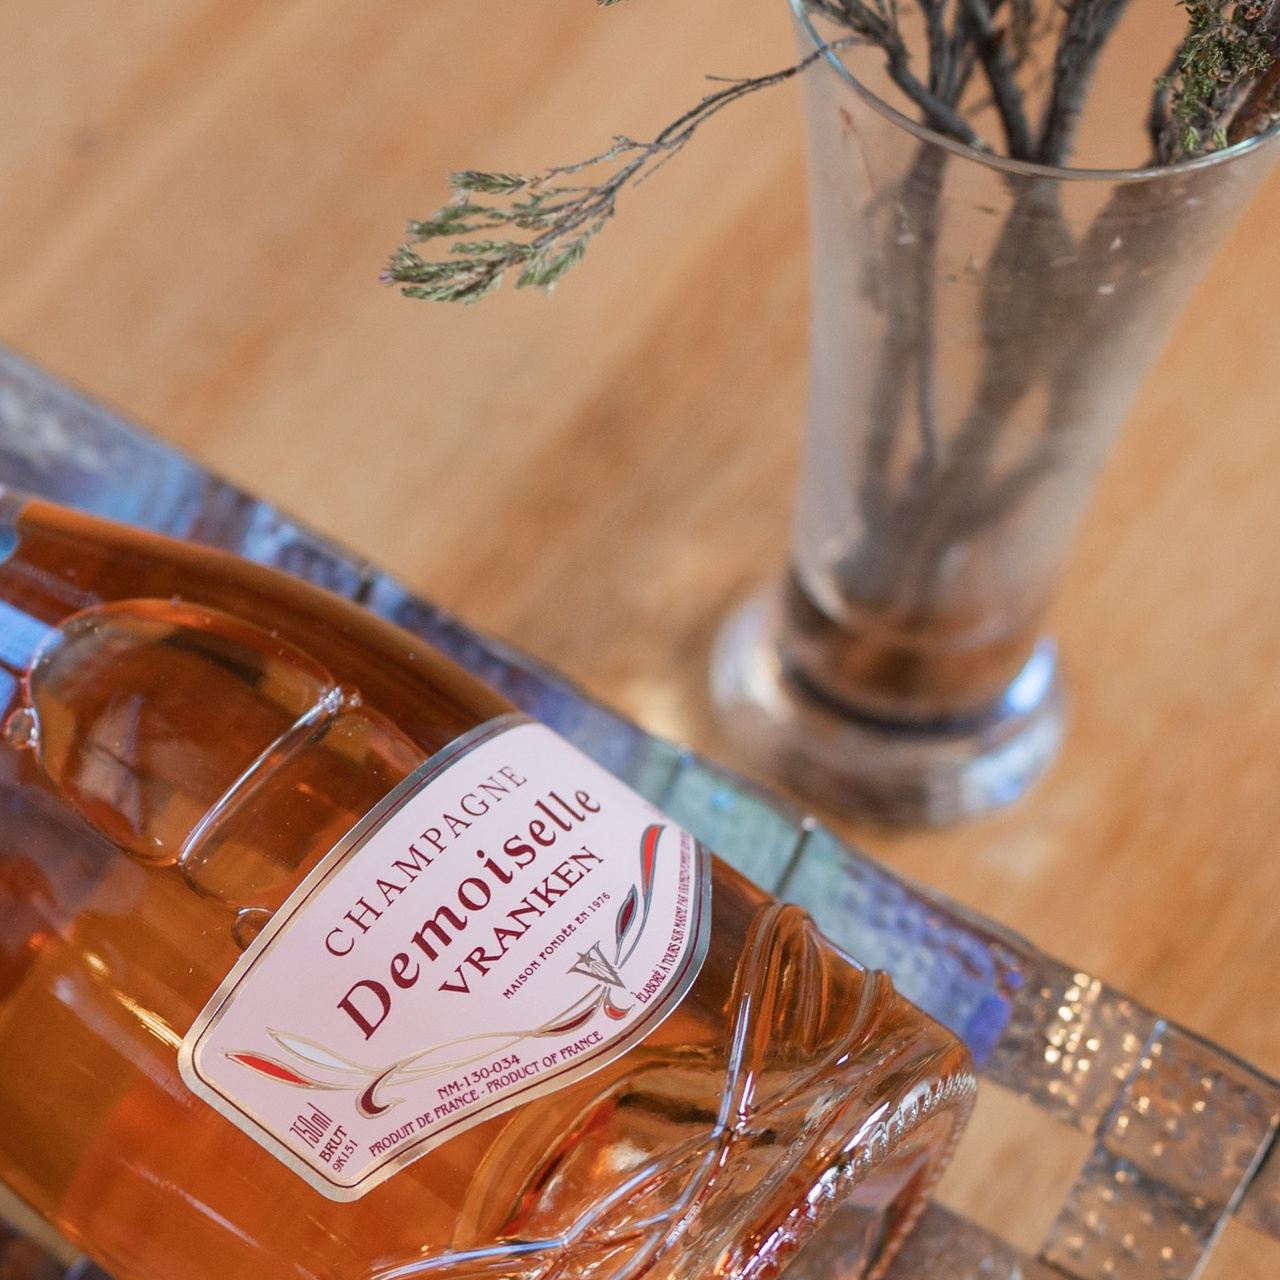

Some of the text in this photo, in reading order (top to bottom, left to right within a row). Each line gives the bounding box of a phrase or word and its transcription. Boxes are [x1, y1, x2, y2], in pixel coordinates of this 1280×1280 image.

[325, 765, 528, 957] CHAMPAGNE
[336, 788, 602, 1041] Demoiselle
[437, 846, 604, 997] VRANKEN
[670, 926, 685, 946] SUR
[503, 892, 611, 999] MAISON FONDÉE EN 1976
[661, 943, 681, 969] TOURS
[635, 969, 667, 1004] ÉLABORÉ
[368, 1121, 415, 1157] PRODUIT
[415, 1112, 434, 1128] DE
[434, 1089, 480, 1120] FRANCE
[487, 1061, 539, 1093] PRODUCT
[542, 1053, 558, 1068] OF
[559, 1031, 603, 1060] FRANCE
[436, 1054, 520, 1099] NM-130-034
[289, 1102, 333, 1149] 750ml
[319, 1125, 348, 1163] BRUT
[332, 1139, 359, 1173] 9K151
